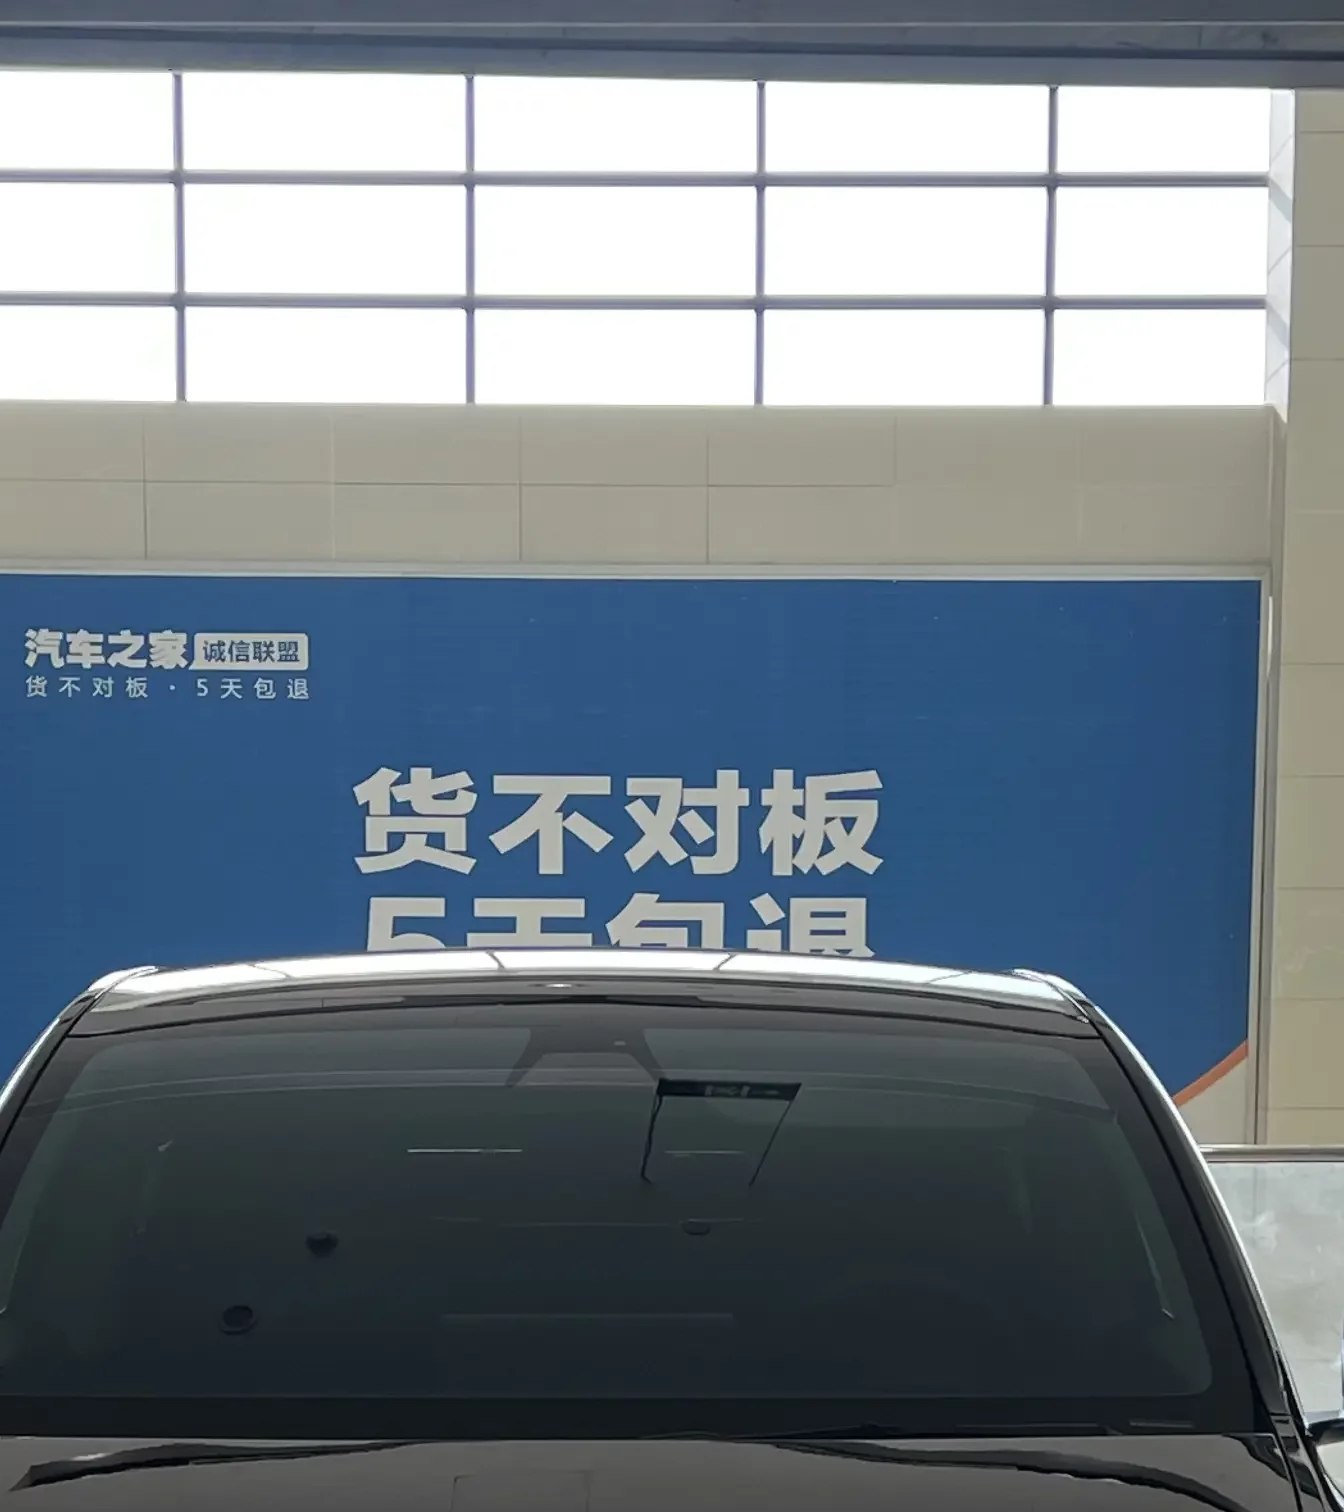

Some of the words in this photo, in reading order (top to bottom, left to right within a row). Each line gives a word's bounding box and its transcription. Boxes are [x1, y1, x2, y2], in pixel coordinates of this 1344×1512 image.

[24, 628, 188, 670] 汽车之家
[202, 639, 301, 663] 诚信联盟
[352, 766, 884, 876] 货不对板
